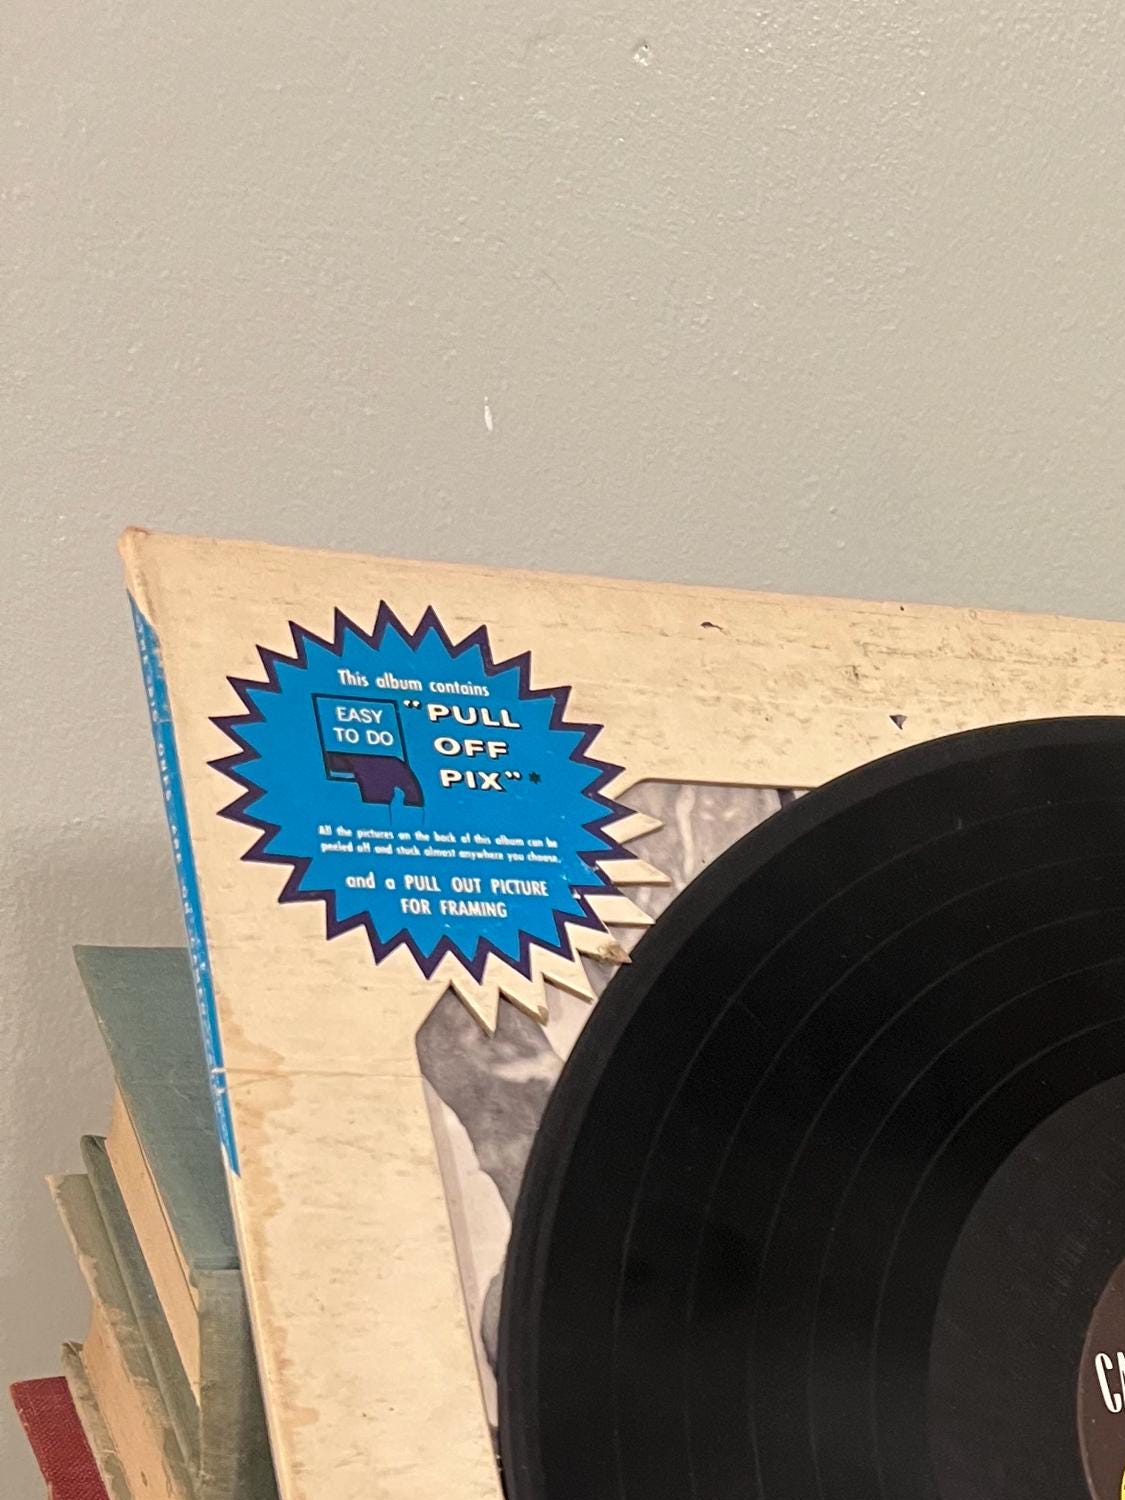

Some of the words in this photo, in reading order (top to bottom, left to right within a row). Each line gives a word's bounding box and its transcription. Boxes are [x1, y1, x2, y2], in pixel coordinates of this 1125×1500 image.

[337, 669, 369, 687] This
[376, 672, 423, 692] album
[429, 681, 490, 697] contains
[336, 707, 383, 724] EASY
[333, 727, 359, 744] TO
[366, 730, 394, 746] DO
[433, 736, 510, 760] OFF
[318, 825, 332, 836] All
[336, 825, 352, 837] the
[357, 829, 394, 839] pictures
[398, 832, 411, 840] on
[415, 831, 430, 841] the
[433, 831, 456, 843] back
[461, 832, 471, 843] of
[474, 833, 491, 844] this
[495, 835, 524, 846] album
[527, 839, 543, 847] can
[546, 836, 558, 848] be
[321, 841, 353, 852] peeled
[357, 842, 370, 853] off
[374, 843, 393, 854] and
[396, 845, 420, 856] stuck
[424, 846, 456, 857] almost
[458, 849, 503, 861] anywhere
[507, 852, 524, 862] you
[345, 871, 376, 889] and
[385, 878, 396, 890] a
[404, 874, 441, 892] PULL
[451, 877, 481, 893] OUT
[490, 878, 549, 896] PICTURE
[400, 898, 432, 915] FOR
[439, 900, 507, 918] FRAMING
